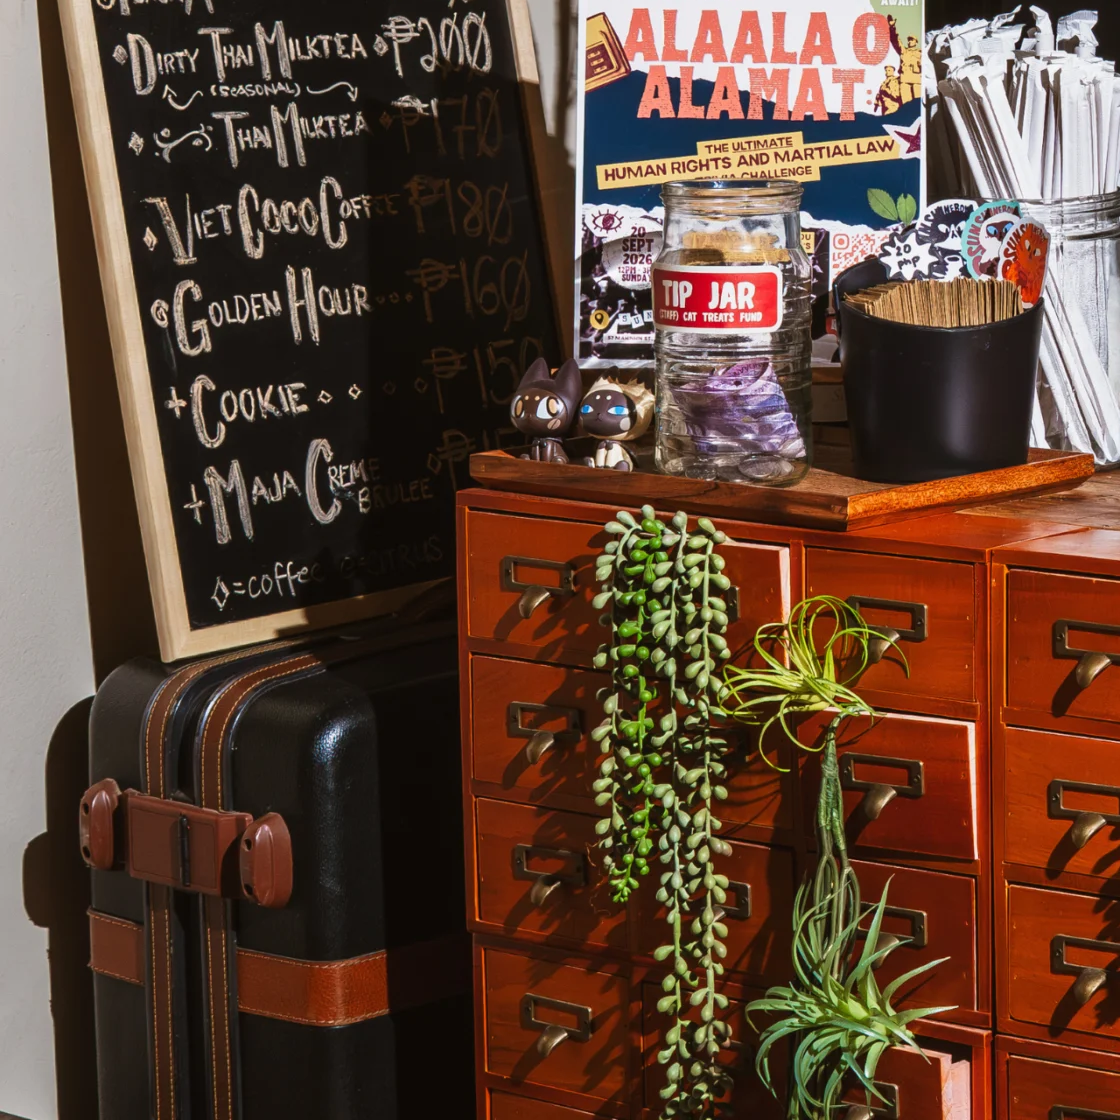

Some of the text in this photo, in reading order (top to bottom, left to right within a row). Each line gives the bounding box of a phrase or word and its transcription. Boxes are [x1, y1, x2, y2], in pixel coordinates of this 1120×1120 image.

[623, 8, 891, 66] ALAALA O
[704, 136, 793, 154] THE ULTIMATE
[604, 138, 896, 181] HUMAN RIGHTS AND MARTIAL LAW
[741, 166, 813, 180] CHALLENGE
[630, 226, 646, 238] 20
[622, 238, 654, 252] SEPT
[895, 244, 912, 256] 20
[622, 253, 652, 265] 2026
[662, 280, 756, 310] TIP JAR
[173, 279, 282, 356] GOLDEN
[284, 264, 374, 346] HOUR
[683, 312, 697, 322] CAT
[702, 312, 735, 322] TREATS
[740, 312, 763, 323] FUND
[190, 374, 311, 449] COOKIE
